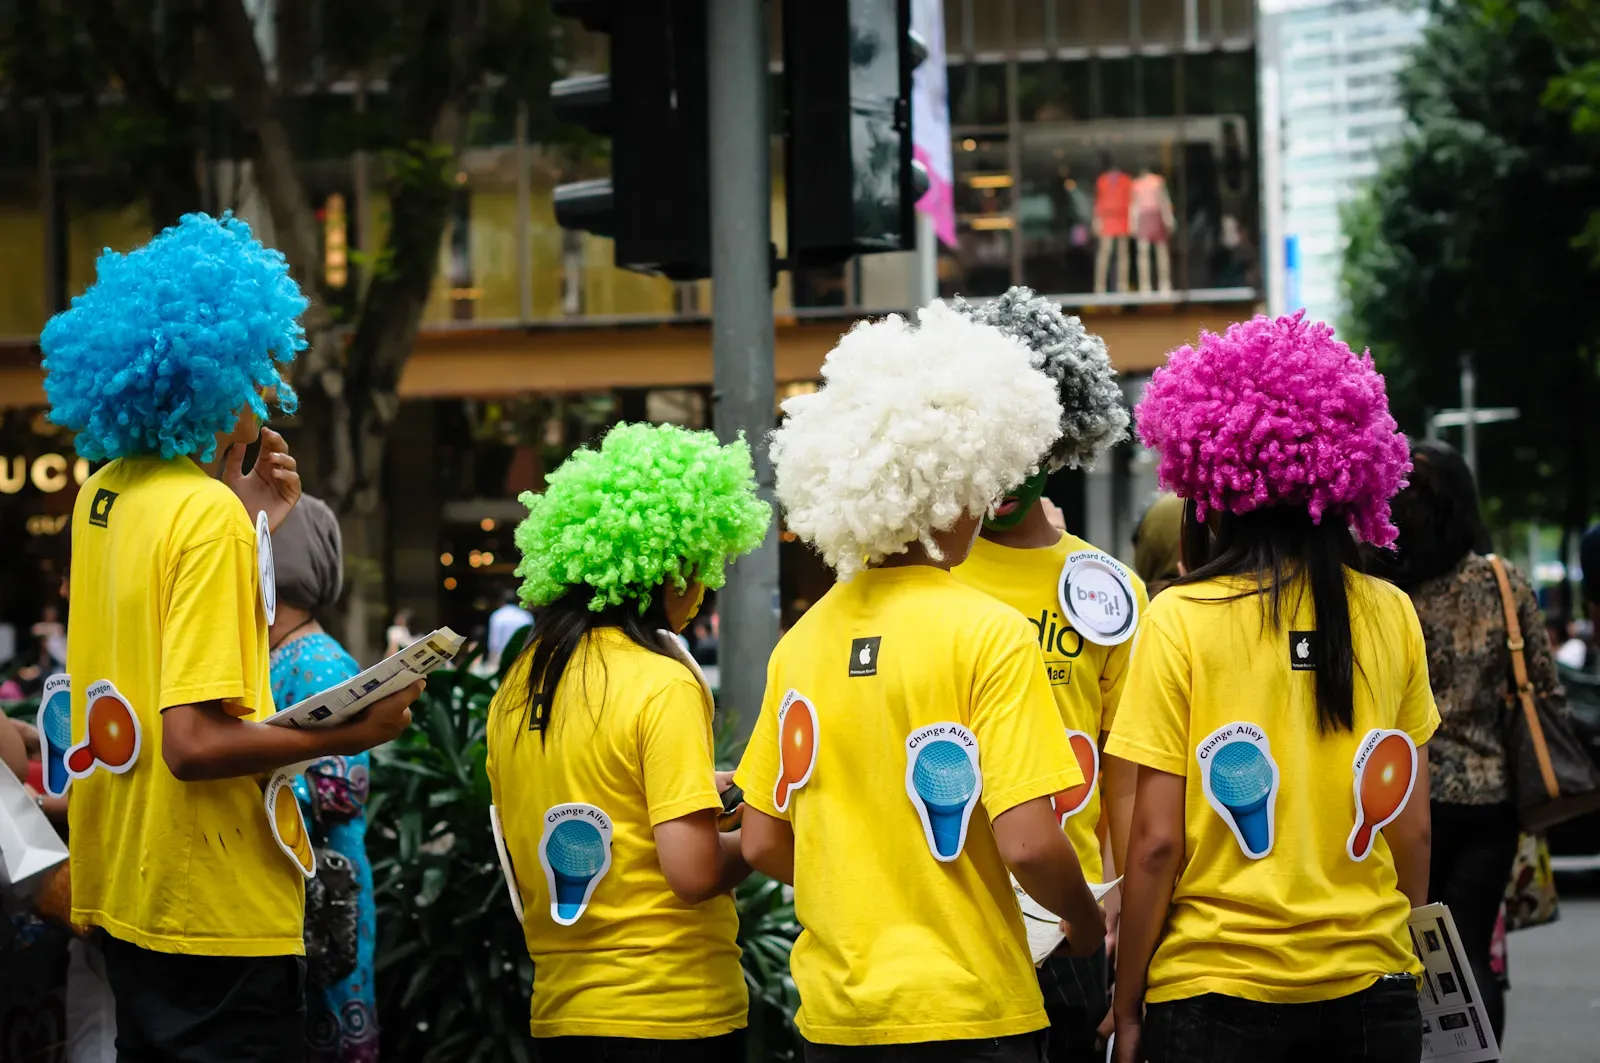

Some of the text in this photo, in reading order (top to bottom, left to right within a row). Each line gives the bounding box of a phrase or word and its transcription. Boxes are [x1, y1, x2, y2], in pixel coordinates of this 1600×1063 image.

[1070, 553, 1127, 578] Orchard Central
[1076, 586, 1108, 604] bop
[87, 684, 111, 698] Paragon
[779, 691, 794, 720] Paragon
[909, 726, 974, 749] Change Alley
[1200, 726, 1264, 759] Change Alley
[1356, 732, 1381, 769] Paragon
[547, 808, 609, 830] Change Alley
